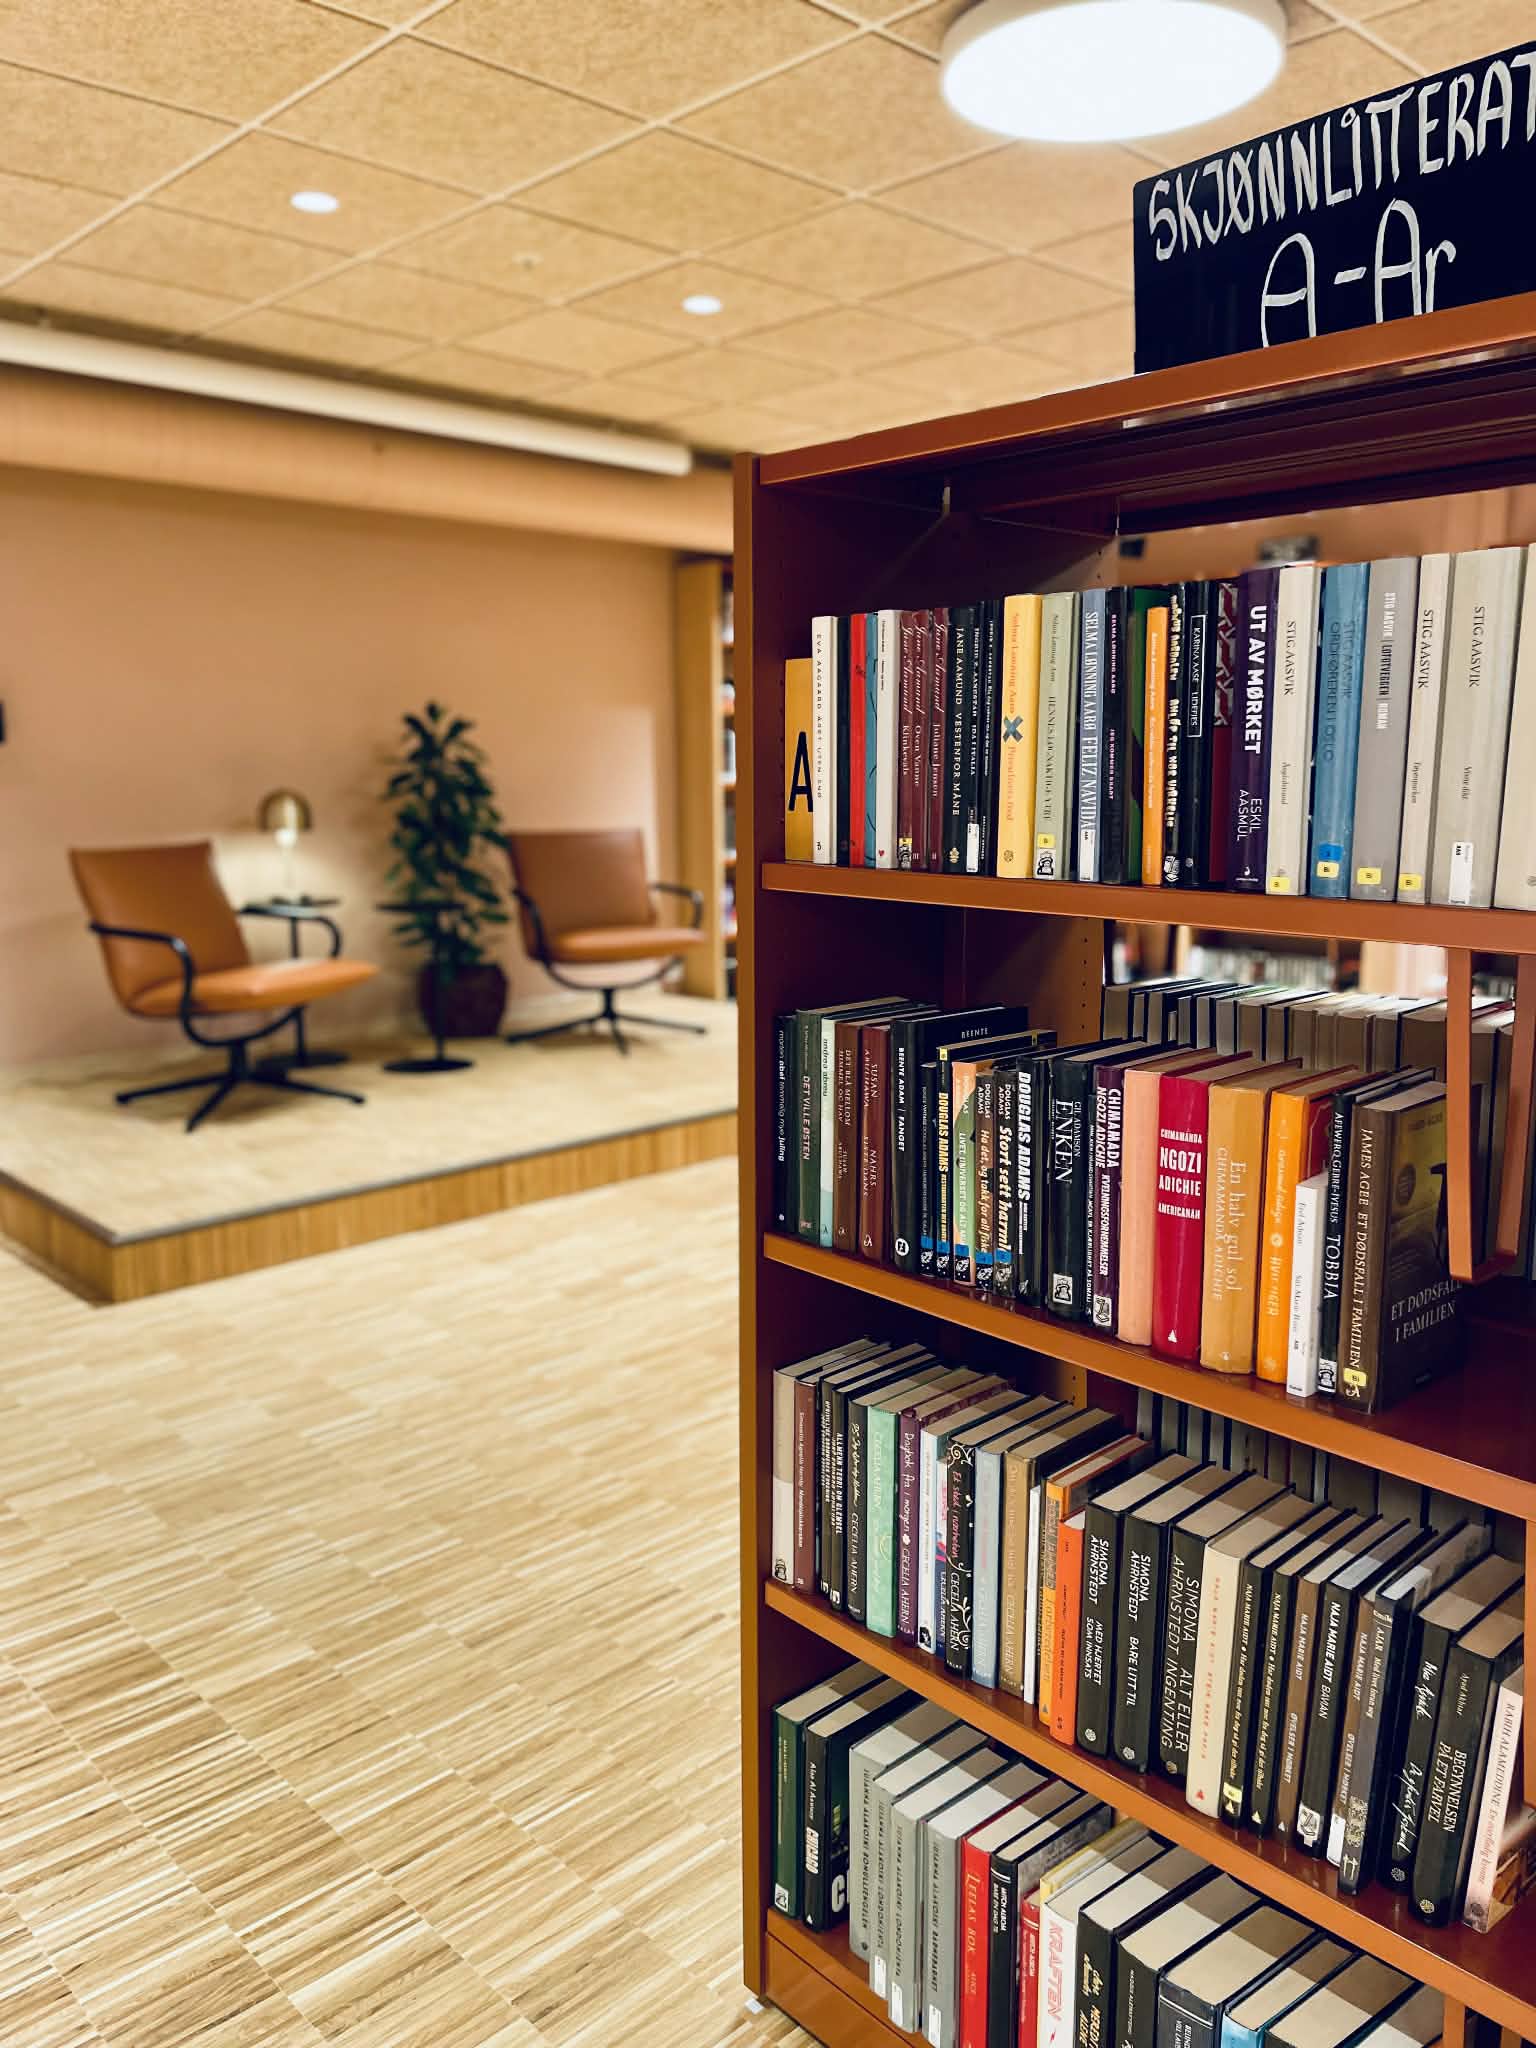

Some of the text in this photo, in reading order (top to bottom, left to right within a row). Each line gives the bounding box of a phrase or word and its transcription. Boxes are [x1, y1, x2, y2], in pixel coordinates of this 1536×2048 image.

[1417, 609, 1434, 689] STIG AASVIK
[1472, 606, 1485, 636] STIG
[1191, 627, 1201, 683] KARINA AASE
[1244, 605, 1267, 754] UT AV MØRKET
[1283, 621, 1296, 696] STIG AASVIK
[1376, 592, 1396, 729] STIG AASVIK LOFOTVEGGEN ROMAN
[1467, 639, 1483, 688] AASVIK
[952, 628, 964, 816] JANE AAMUND VESTENFOR MÅNE
[1081, 612, 1098, 776] SELMA LØNNING AARØ FELIZ
[1236, 789, 1250, 841] AASMUL
[1249, 798, 1262, 833] ESKIL
[822, 1038, 830, 1096] andrea abreu
[844, 1070, 852, 1086] BLÅ
[870, 1063, 878, 1097] SUSAN
[938, 1092, 948, 1172] DOUGLAS ADAMS
[1004, 1083, 1012, 1120] DOUGLAS
[1018, 1071, 1031, 1143] DOUGLAS
[1073, 1101, 1081, 1157] GIL ADAMSON
[1095, 1086, 1107, 1168] NGOZI ADICHIE
[869, 1149, 877, 1186] NAHRS
[1055, 1099, 1074, 1184] ENKEN
[1159, 1146, 1202, 1174] NGOZI
[1160, 1128, 1203, 1144] CHIMAMANDA
[1331, 1112, 1343, 1160] AFEWERQ
[1360, 1128, 1373, 1169] JAMES
[977, 1130, 990, 1230] Ha det, og takk for all
[998, 1125, 1012, 1250] Stort sett harml
[1018, 1144, 1031, 1201] ADAMS
[1158, 1174, 1201, 1196] ADICHIE
[1358, 1171, 1370, 1205] AGEE
[1158, 1202, 1201, 1220] AMERICANAH
[1212, 1147, 1227, 1300] CHIMAMANDA ADICHIE
[1225, 1160, 1247, 1291] En halv gul sol
[1357, 1212, 1368, 1228] ET
[1323, 1234, 1341, 1300] TOBBIA
[1353, 1231, 1368, 1296] DØDSFALL
[1349, 1307, 1363, 1368] FAMILIEN
[900, 1432, 915, 1489] Dagbok fra
[836, 1490, 842, 1501] OM
[851, 1513, 859, 1557] CECELIA
[1097, 1539, 1109, 1586] SIMONA
[850, 1559, 858, 1594] AHERN
[901, 1548, 910, 1623] CECELIA AHERN
[1088, 1535, 1099, 1605] AHRNSTEDT
[1127, 1550, 1140, 1622] AHRNSTEDT
[1138, 1554, 1151, 1602] SIMONA
[950, 1572, 960, 1651] CECELIA AHERN
[1167, 1554, 1185, 1655] AHRNSTEDT
[1182, 1576, 1200, 1642] SIMONA
[1084, 1616, 1094, 1679] SOM INNSATS
[1092, 1620, 1103, 1685] MED HJERTET
[1126, 1636, 1139, 1707] BARE LITT TIL
[1295, 1613, 1309, 1681] NAJA MARIE AIDT
[1319, 1601, 1341, 1719] NAJA MARIE AIDT BAVIAN
[1353, 1632, 1369, 1701] NAJA MARIE AIDT
[1372, 1657, 1382, 1670] Med
[1375, 1627, 1385, 1651] AJAR
[1161, 1657, 1178, 1749] INGENTING
[1175, 1667, 1193, 1751] ALT ELLER
[1456, 1672, 1469, 1716] Ayad Akhtar
[1427, 1741, 1453, 1826] PÅ ET FARVEL
[1490, 1703, 1516, 1807] RABIH ALAMEDDINE
[1442, 1750, 1467, 1833] BEGYNNELSEN
[805, 1826, 819, 1874] CHICAGO
[965, 1872, 981, 1954] LEELAS BOK
[1000, 1887, 1008, 1907] MITCH
[1047, 1920, 1064, 2021] KRAFTEN
